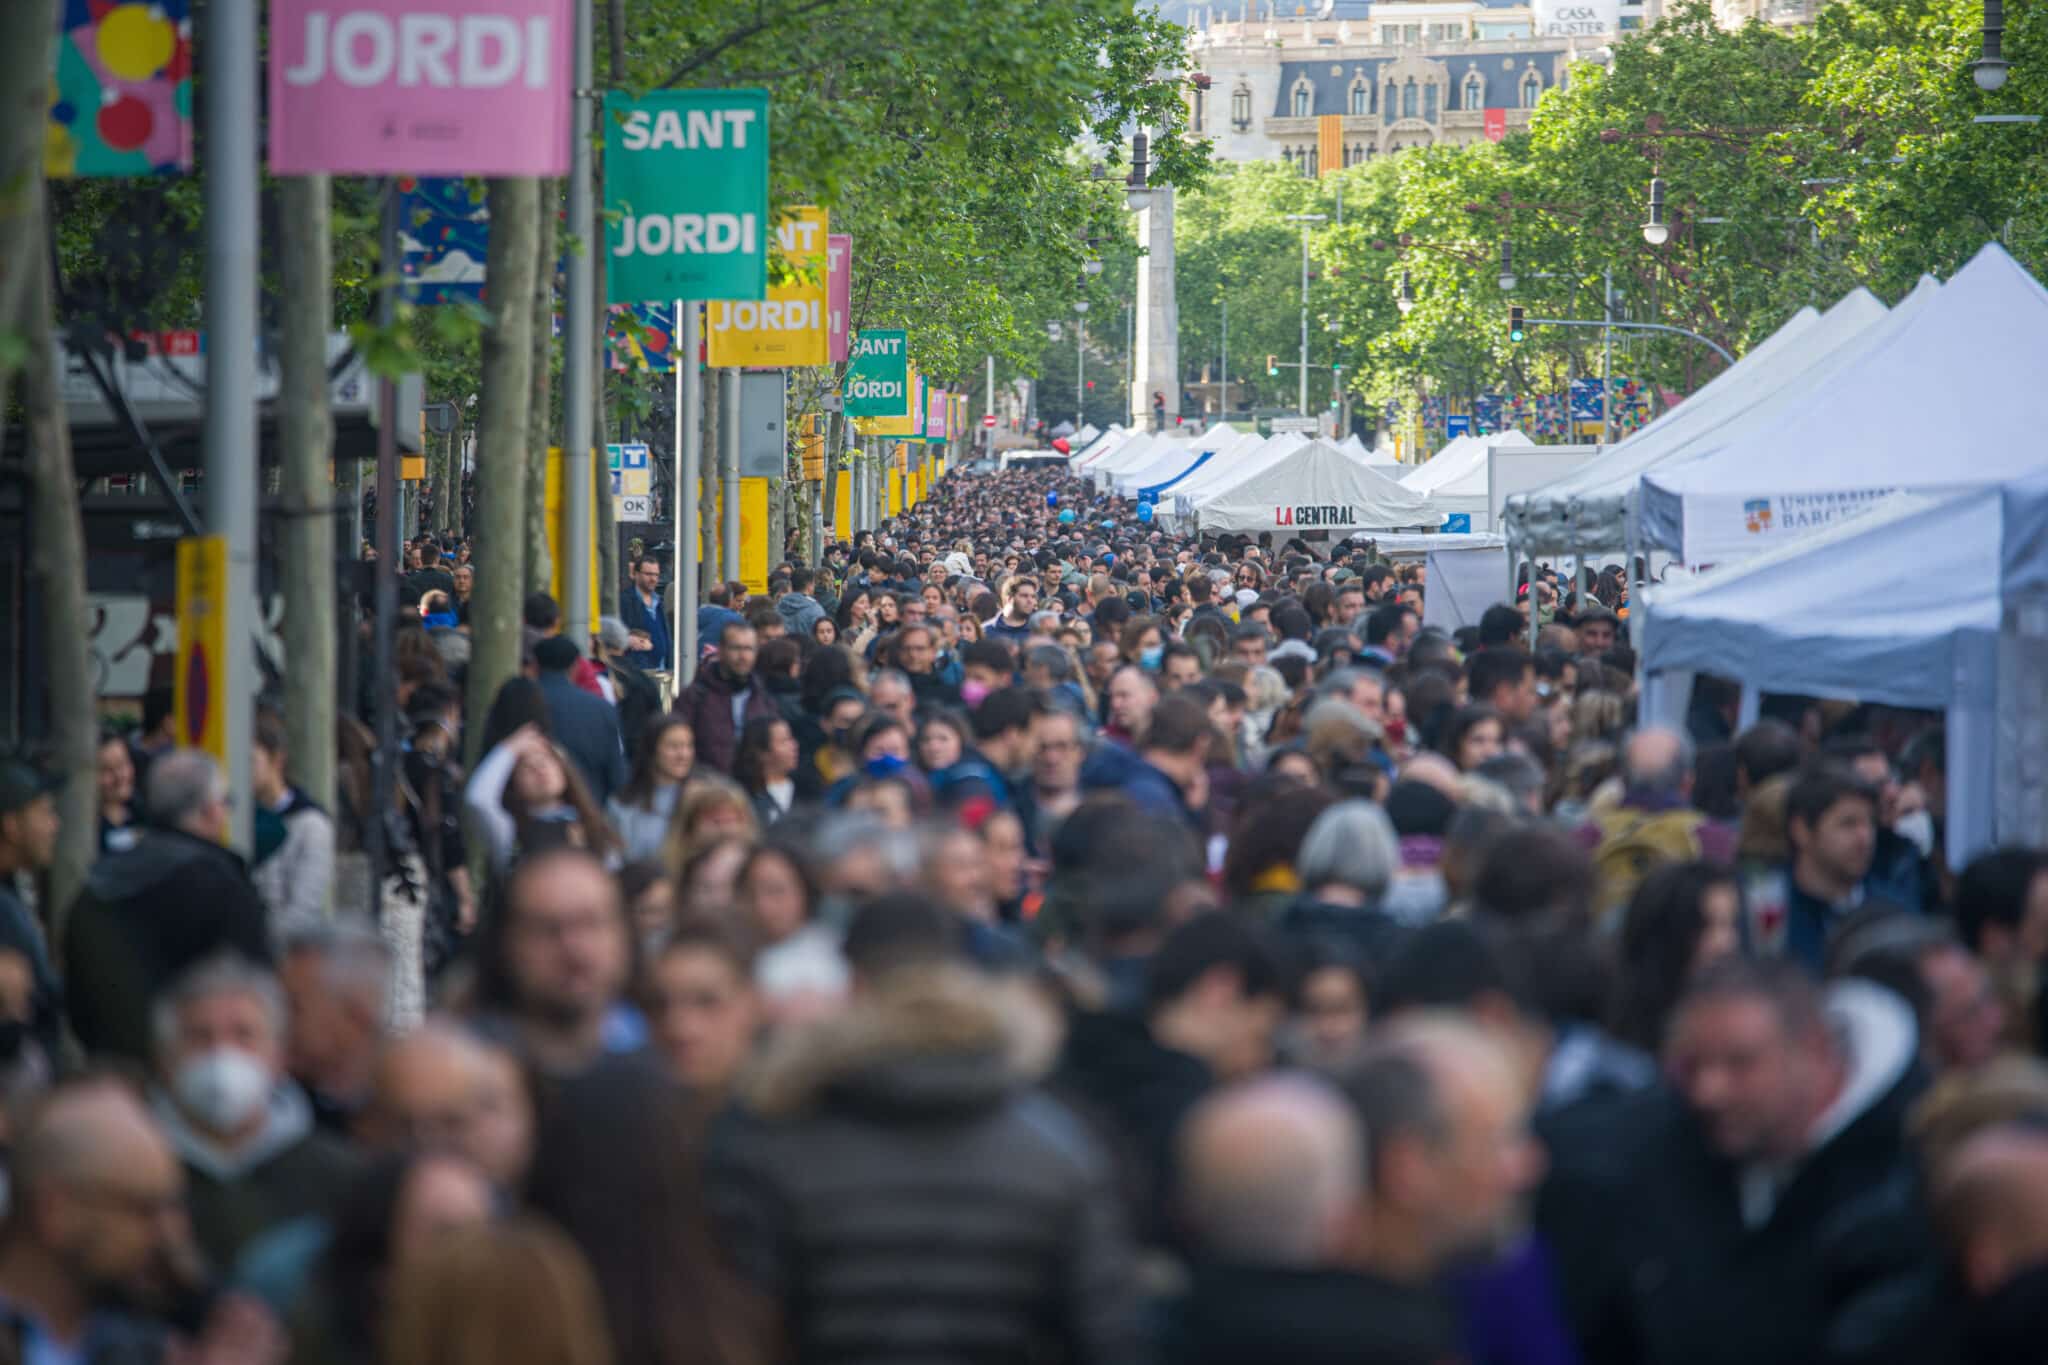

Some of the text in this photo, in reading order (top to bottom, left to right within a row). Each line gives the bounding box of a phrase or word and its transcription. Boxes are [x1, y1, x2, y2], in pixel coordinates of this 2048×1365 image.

[1555, 8, 1597, 20] CASA
[1550, 22, 1605, 34] FUSTER
[284, 12, 549, 89] JORDI
[622, 109, 756, 150] SANT
[613, 213, 756, 257] JORDI
[776, 222, 819, 251] NT
[713, 300, 820, 332] JORDI
[844, 381, 902, 398] JORDI
[624, 500, 645, 511] OK
[1276, 505, 1357, 526] LA CENTRAL
